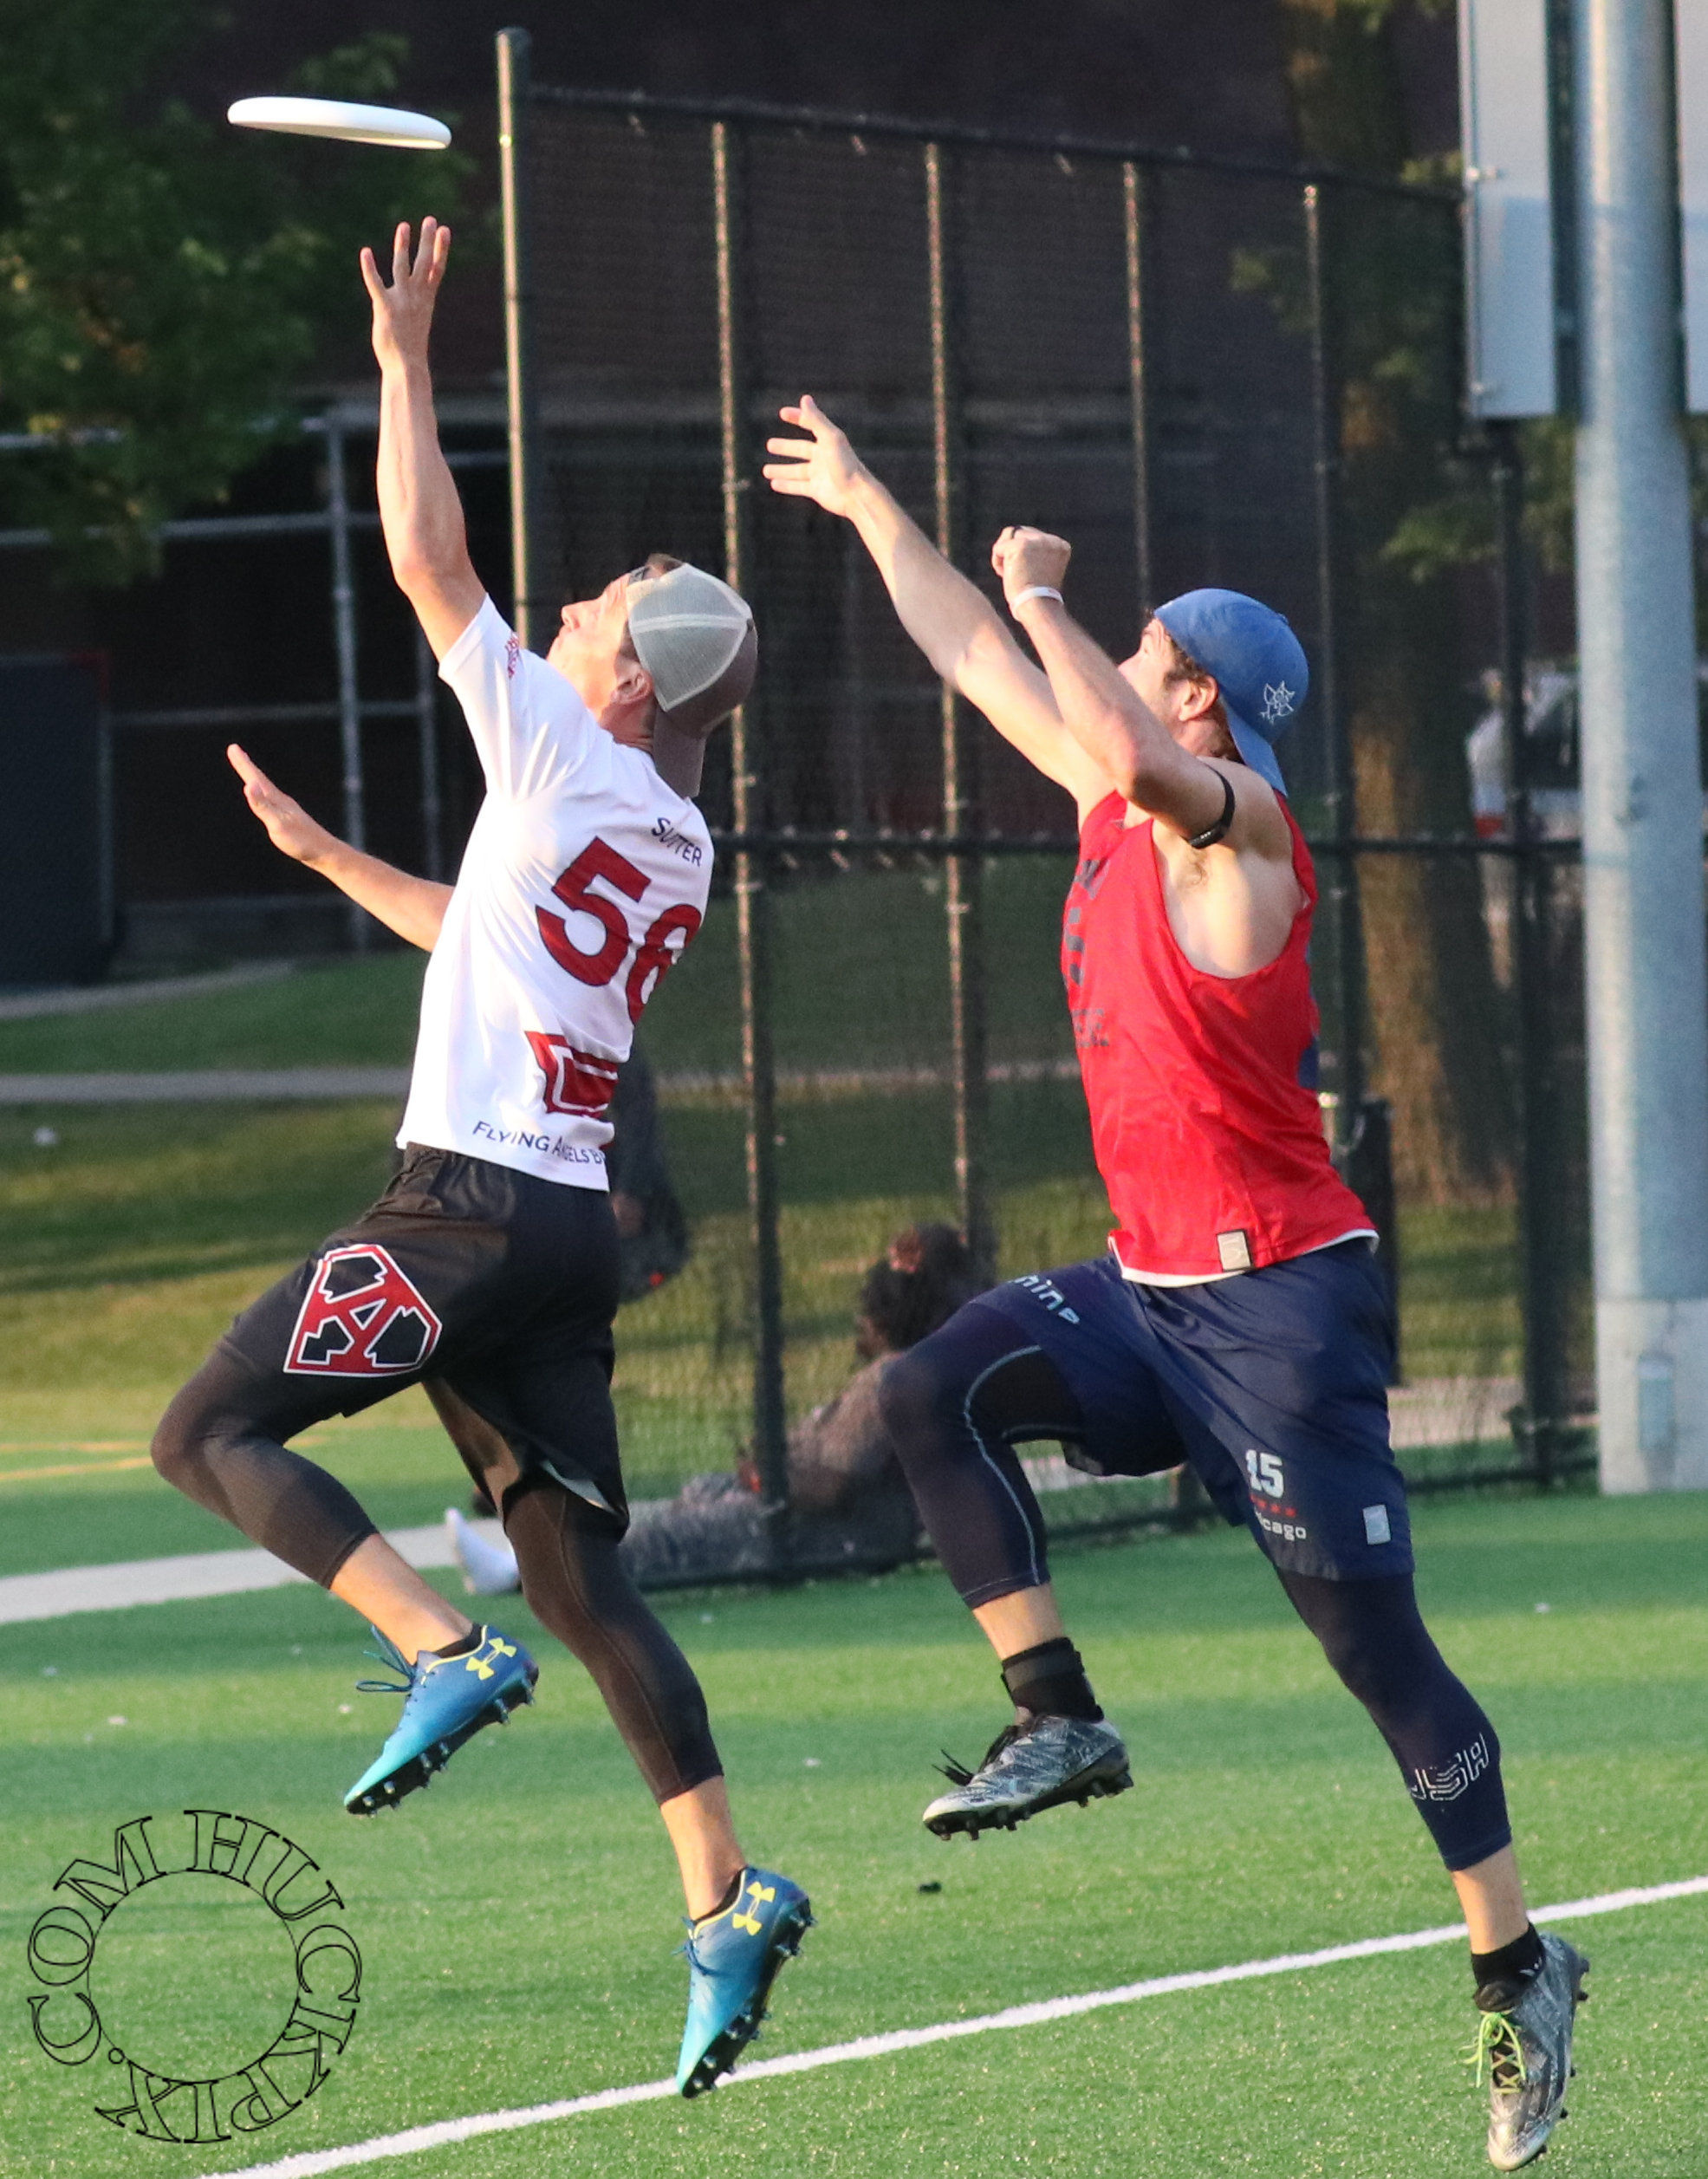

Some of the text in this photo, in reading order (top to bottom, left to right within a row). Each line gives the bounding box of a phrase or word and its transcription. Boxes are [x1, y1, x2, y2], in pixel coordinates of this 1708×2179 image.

[651, 817, 702, 868] SUTTER
[472, 1121, 550, 1152] FLYING
[1245, 1449, 1284, 1499] 15
